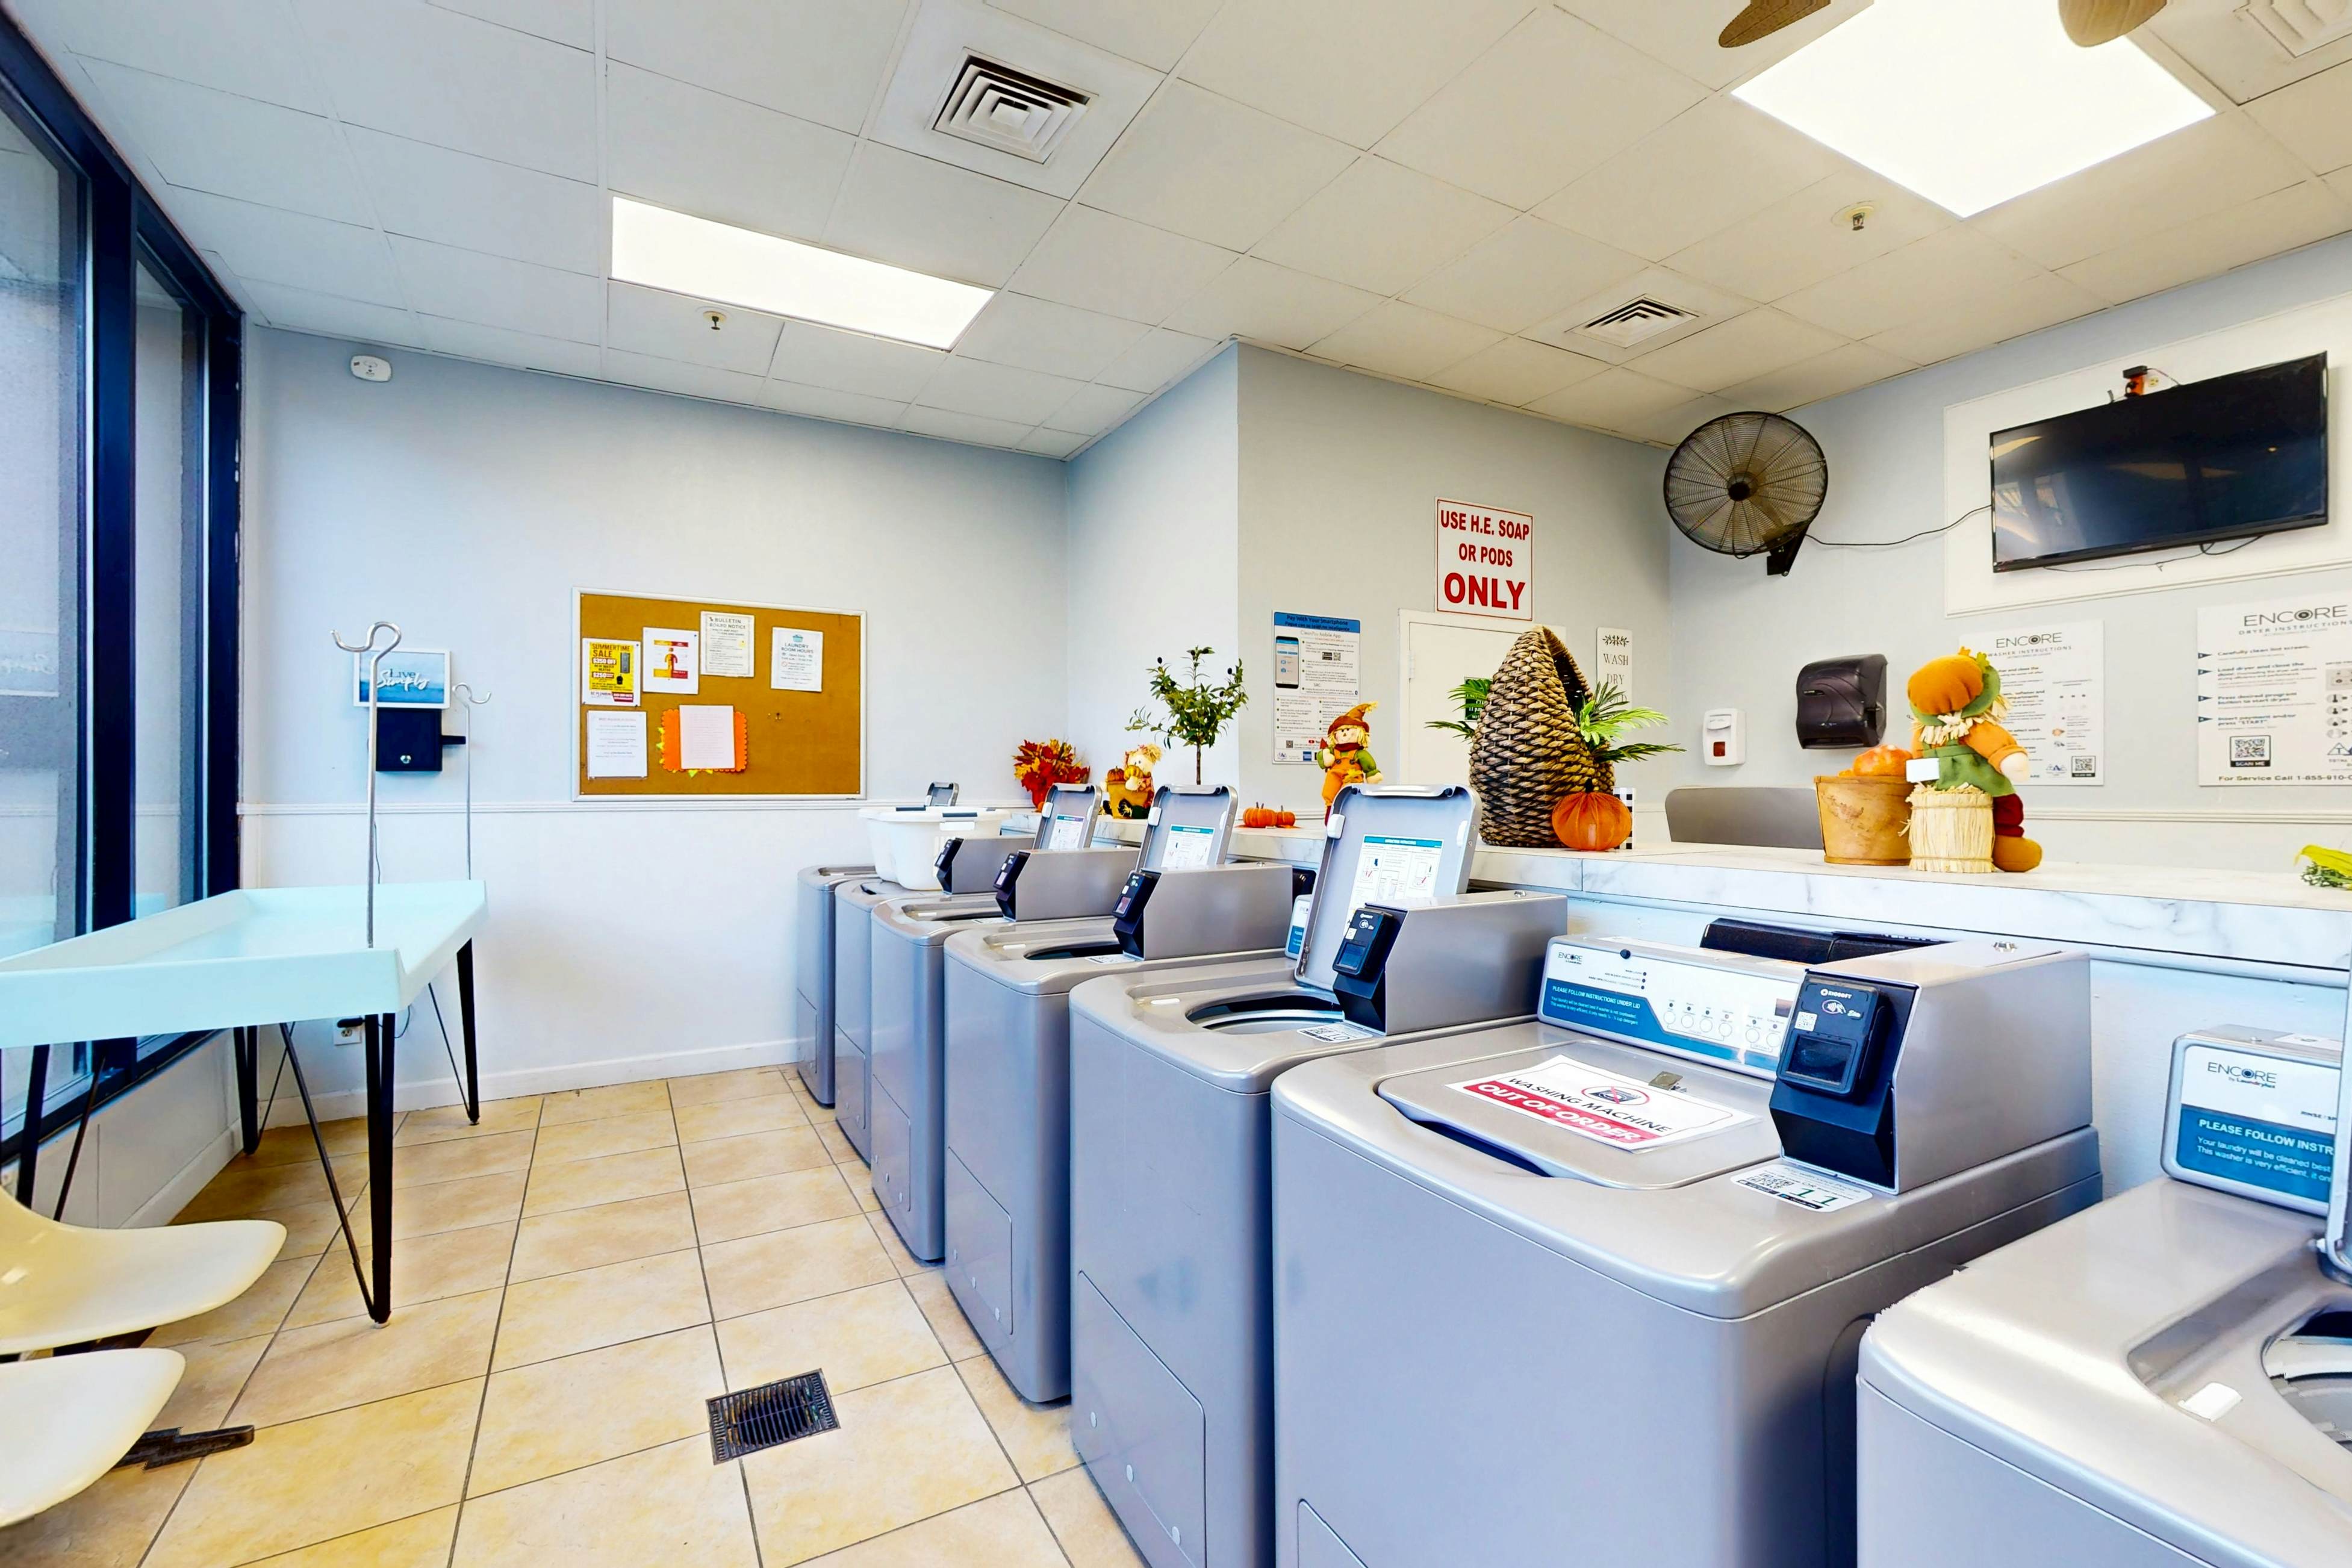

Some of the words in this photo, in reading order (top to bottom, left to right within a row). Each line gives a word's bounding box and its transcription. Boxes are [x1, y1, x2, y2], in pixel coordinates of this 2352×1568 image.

[1440, 510, 1466, 530] USE
[1470, 515, 1494, 535] H.E.
[1499, 520, 1529, 540] SOAP
[1458, 543, 1476, 562] OR
[1481, 546, 1513, 567] PODS
[1444, 572, 1525, 610] ONLY
[2244, 605, 2348, 627] ENCORE
[2275, 620, 2352, 632] INSTRUCTIONS
[1996, 632, 2062, 649] ENCORE
[2019, 646, 2072, 654] INSTRUCTIONS
[1603, 653, 1629, 666] WASH
[376, 669, 429, 692] Simply
[390, 668, 417, 679] Live
[1607, 673, 1625, 685] DRY
[1558, 951, 1583, 962] ENCORE
[1552, 986, 1568, 994] PLEASE
[1568, 989, 1585, 997] FOLLOW
[1585, 993, 1616, 1004] INSTRUCTIONS
[1616, 999, 1632, 1007] UNDER
[2207, 1062, 2277, 1084] ENCORE
[1477, 1084, 1528, 1101] OUT
[1522, 1100, 1562, 1113] OF
[1555, 1110, 1642, 1140] ORDER
[1508, 1078, 1582, 1104] WASHING
[1582, 1102, 1672, 1133] MACHINE
[2198, 1119, 2243, 1136] PLEASE
[2245, 1128, 2295, 1147] FOLLOW
[2297, 1139, 2335, 1156] INSTR
[2197, 1136, 2217, 1146] Your
[2217, 1141, 2247, 1155] laundry
[2248, 1148, 2262, 1157] will
[2263, 1151, 2275, 1160] be
[2276, 1155, 2310, 1168] cleaned
[2311, 1162, 2331, 1172] best
[2197, 1145, 2214, 1156] This
[2215, 1151, 2244, 1162] washer
[2245, 1156, 2253, 1165] is
[2254, 1160, 2273, 1170] very
[2311, 1171, 2317, 1180] it
[2318, 1174, 2332, 1183] on
[1789, 1187, 1838, 1206] 11
